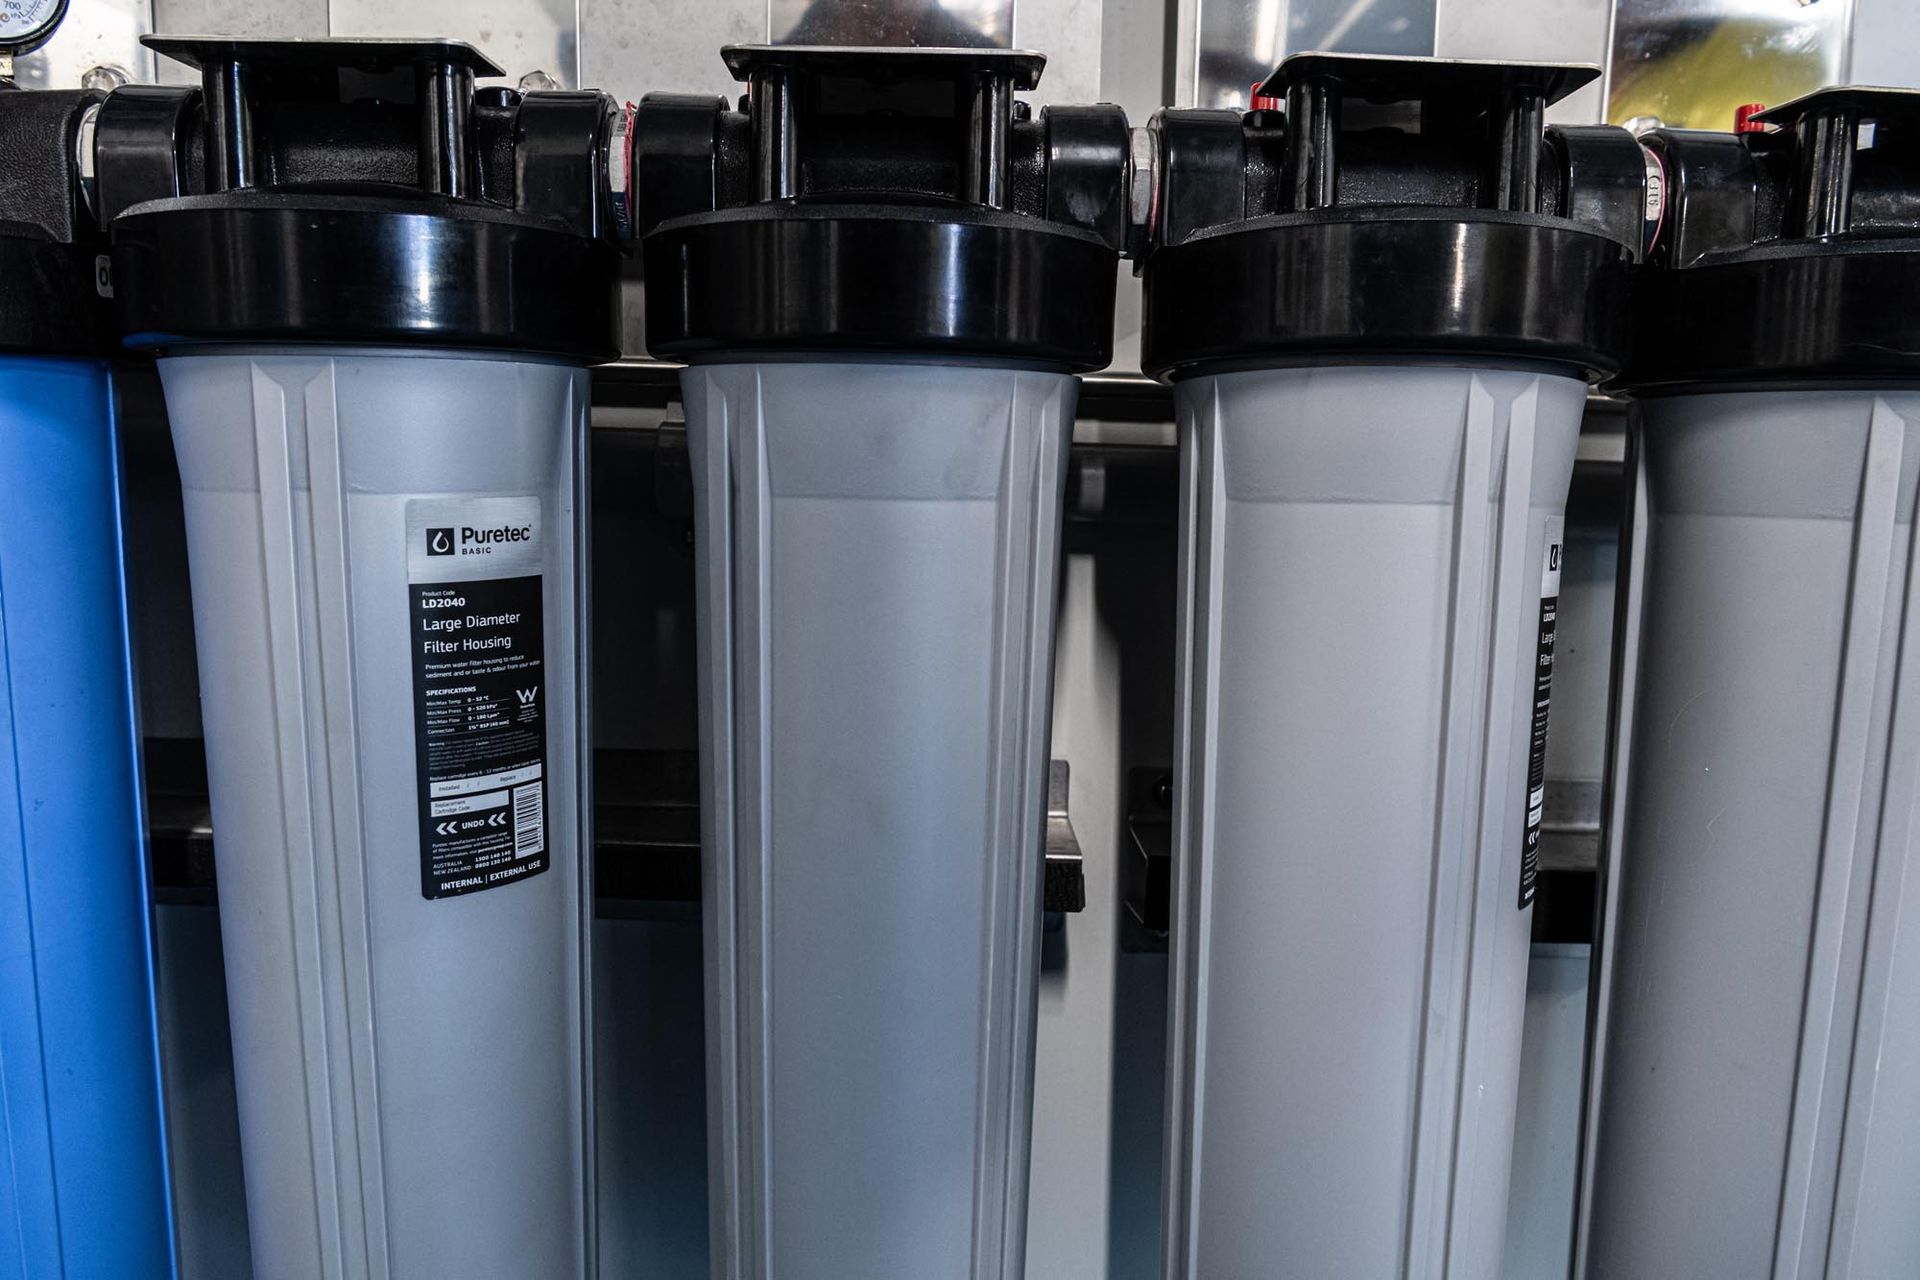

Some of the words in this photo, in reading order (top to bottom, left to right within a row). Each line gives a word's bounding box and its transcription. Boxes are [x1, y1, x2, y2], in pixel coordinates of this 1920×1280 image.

[4, 0, 21, 10] 700
[461, 525, 530, 545] Puretec
[462, 546, 492, 555] BASIC
[422, 598, 466, 609] LD2040
[423, 618, 462, 632] Large
[466, 613, 520, 628] Diameter
[424, 640, 460, 654] Filter
[463, 636, 512, 650] Housing
[426, 686, 476, 696] SPECIFICATIONS
[434, 800, 466, 808] Replacement
[434, 806, 457, 814] Cartridge
[462, 820, 484, 829] UNDO
[433, 860, 462, 869] AUSTRALIA
[475, 854, 490, 862] 1300
[441, 877, 482, 890] INTERNAL
[490, 865, 526, 880] EXTERNAL
[528, 859, 541, 870] USE
[447, 865, 472, 874] ZEALAND
